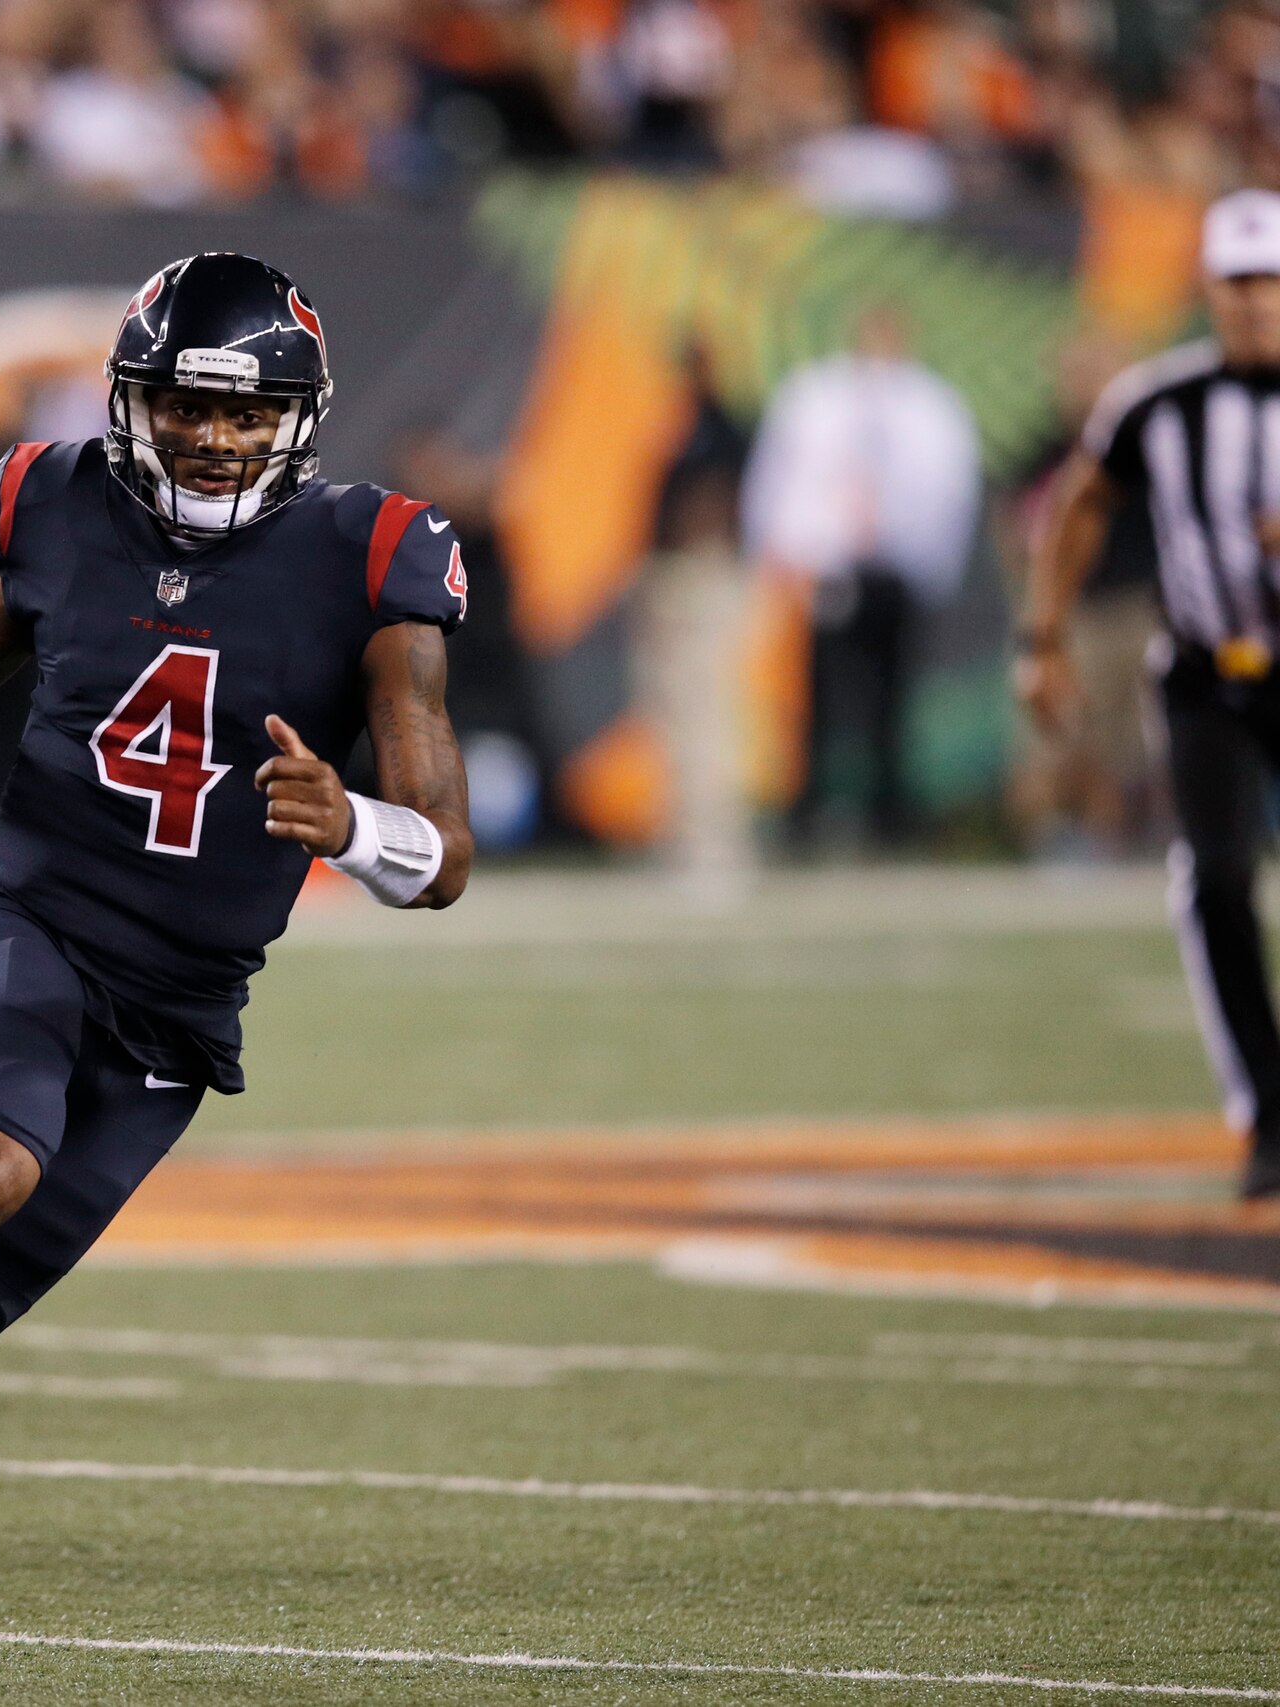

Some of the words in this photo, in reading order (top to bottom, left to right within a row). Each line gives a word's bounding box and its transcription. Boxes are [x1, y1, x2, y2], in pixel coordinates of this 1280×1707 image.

[198, 356, 239, 364] TEXANS
[161, 585, 181, 599] NFL
[444, 541, 468, 621] 4
[129, 616, 211, 638] TEXANS
[88, 644, 233, 857] 4
